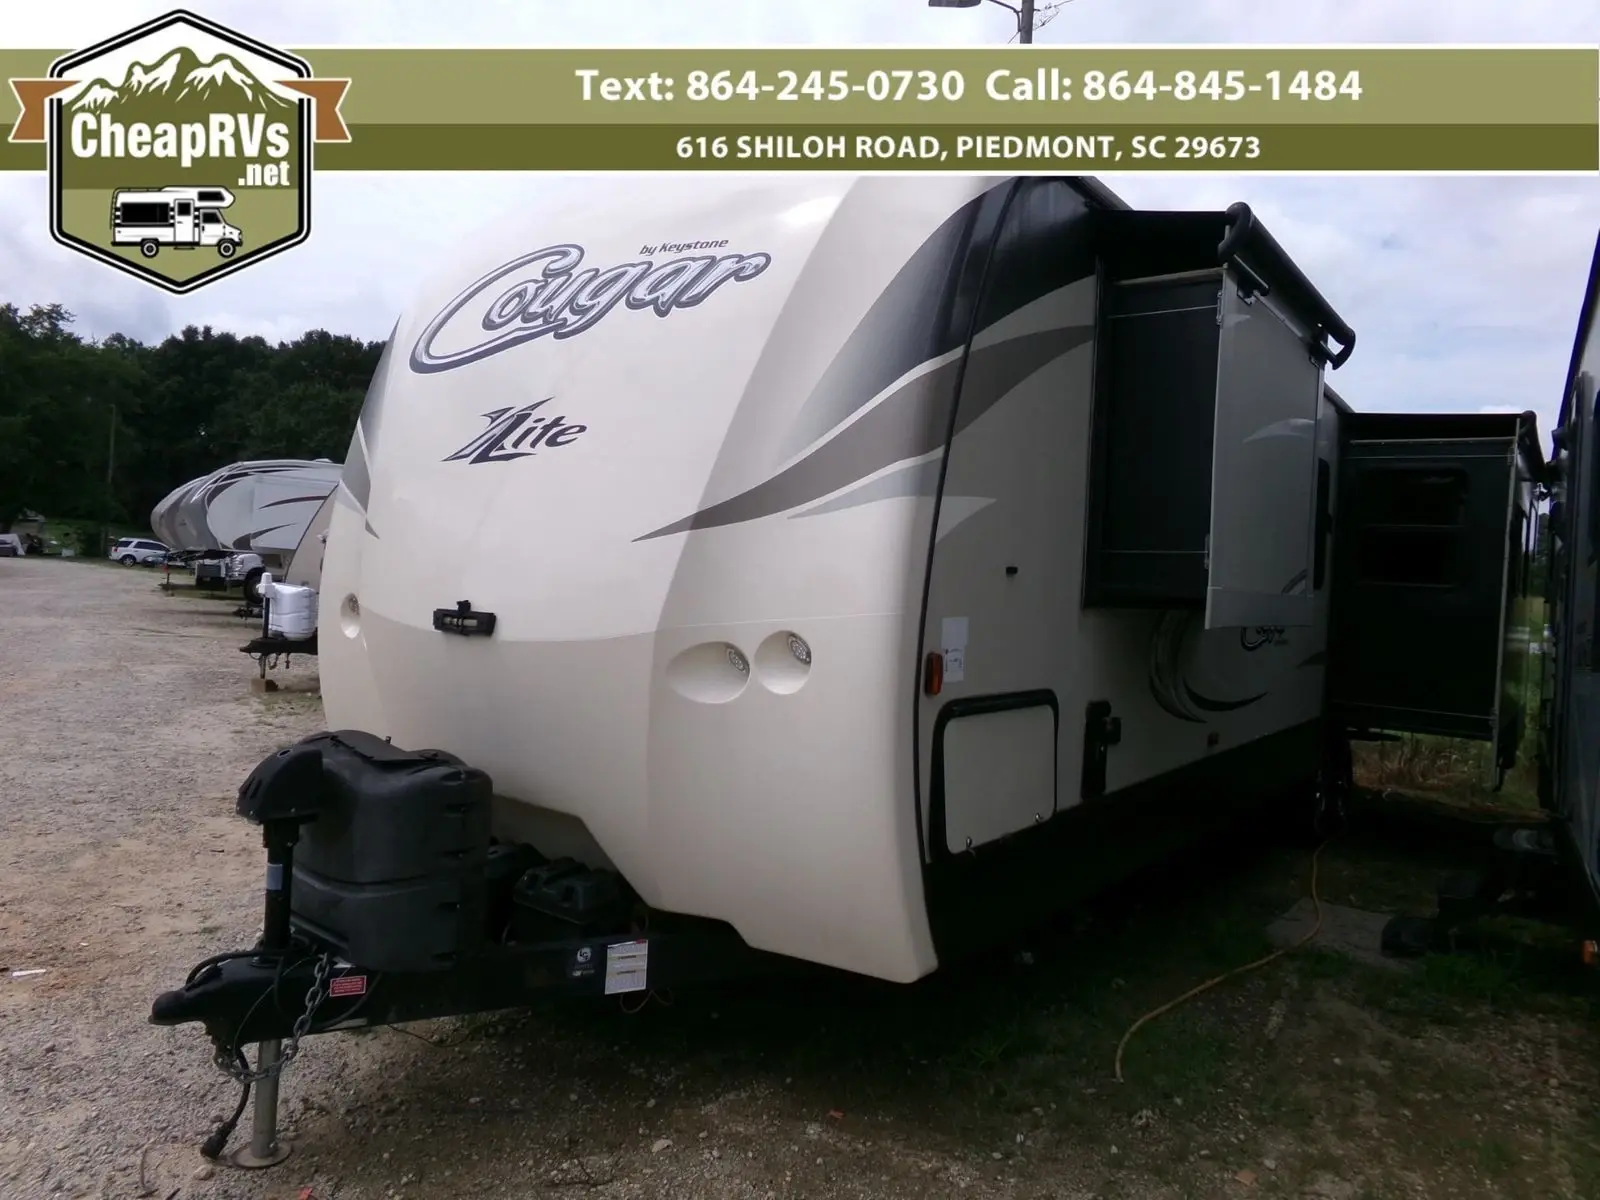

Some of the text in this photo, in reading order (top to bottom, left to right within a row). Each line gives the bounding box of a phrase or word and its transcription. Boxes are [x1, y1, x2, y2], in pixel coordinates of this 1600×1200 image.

[639, 239, 729, 256] by Keystone
[409, 243, 772, 374] Cougar
